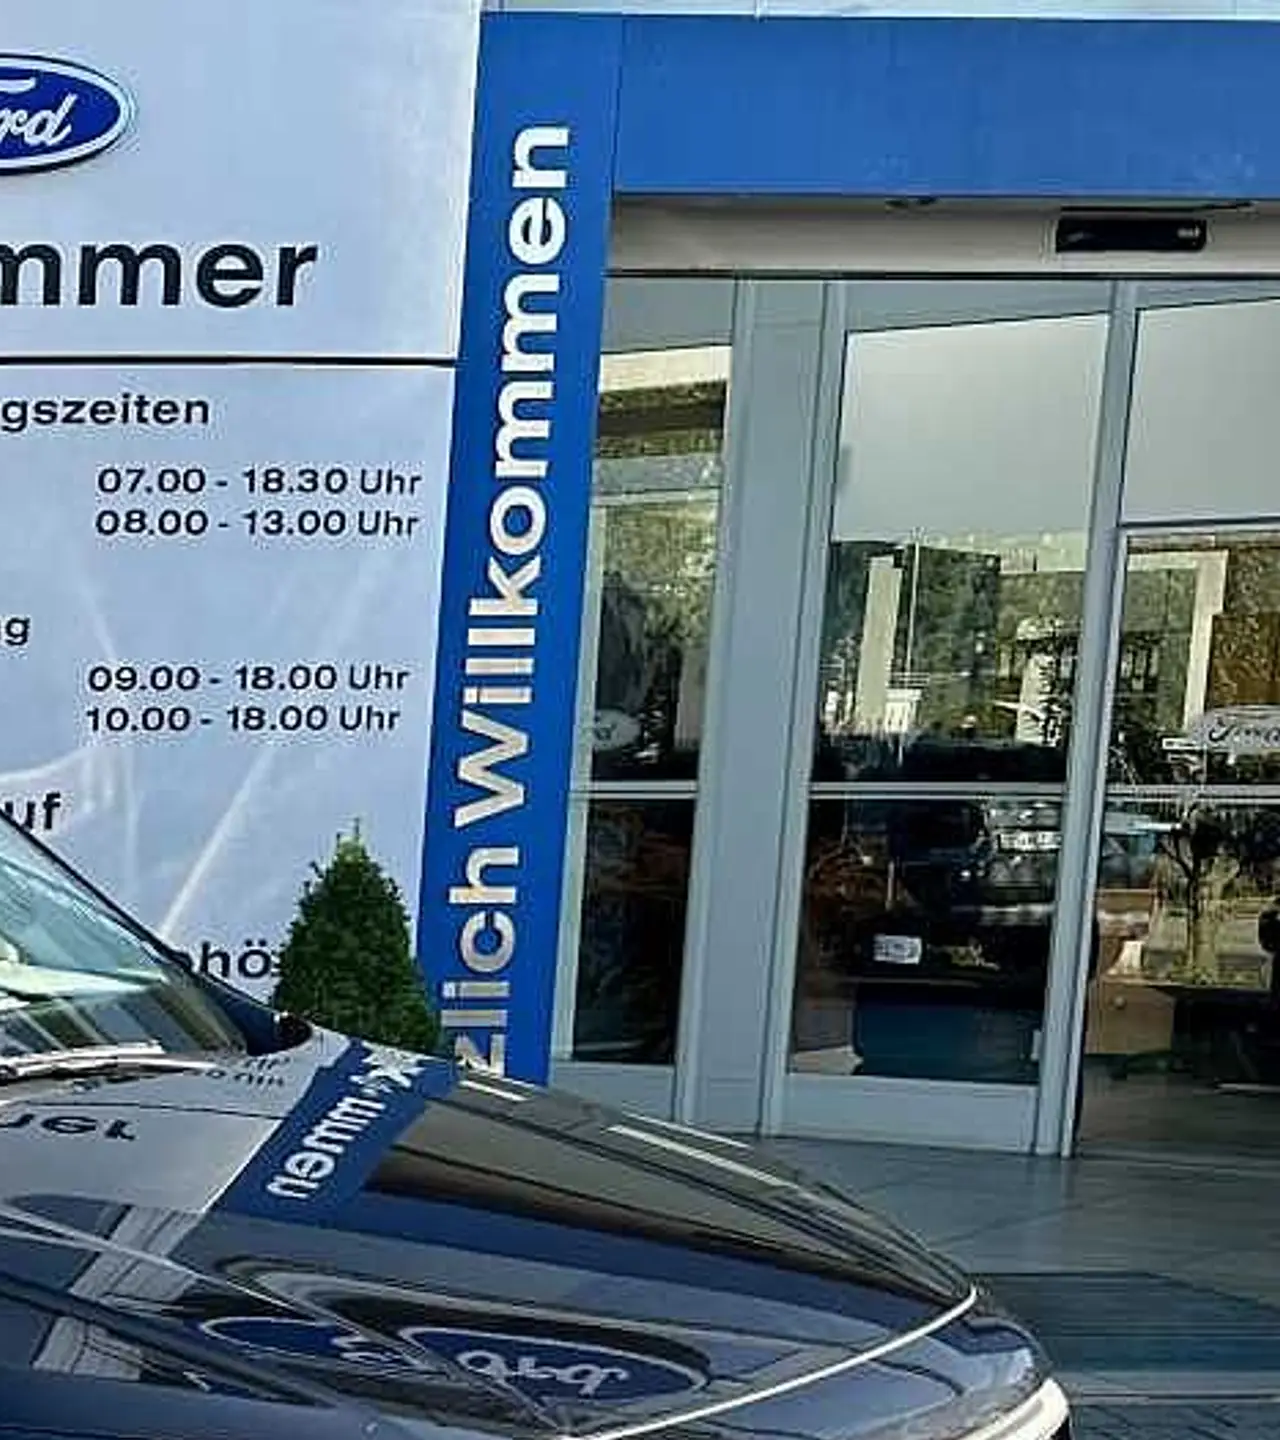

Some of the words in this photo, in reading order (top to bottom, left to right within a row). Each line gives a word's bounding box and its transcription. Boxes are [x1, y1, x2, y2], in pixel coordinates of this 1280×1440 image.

[97, 467, 206, 495] 07.00
[243, 467, 348, 495] 18.30
[359, 467, 423, 496] Uhr
[453, 125, 570, 829] Willkommen
[95, 509, 209, 536] 08.00
[243, 509, 347, 536] 13.00
[356, 509, 421, 538] Uhr
[87, 665, 201, 692] 09.00
[234, 665, 337, 692] 18.00
[347, 663, 411, 691] Uhr
[85, 705, 191, 733] 10.00
[226, 705, 328, 732] 18.00
[339, 704, 401, 733] Uhr
[440, 846, 519, 1079] zlich
